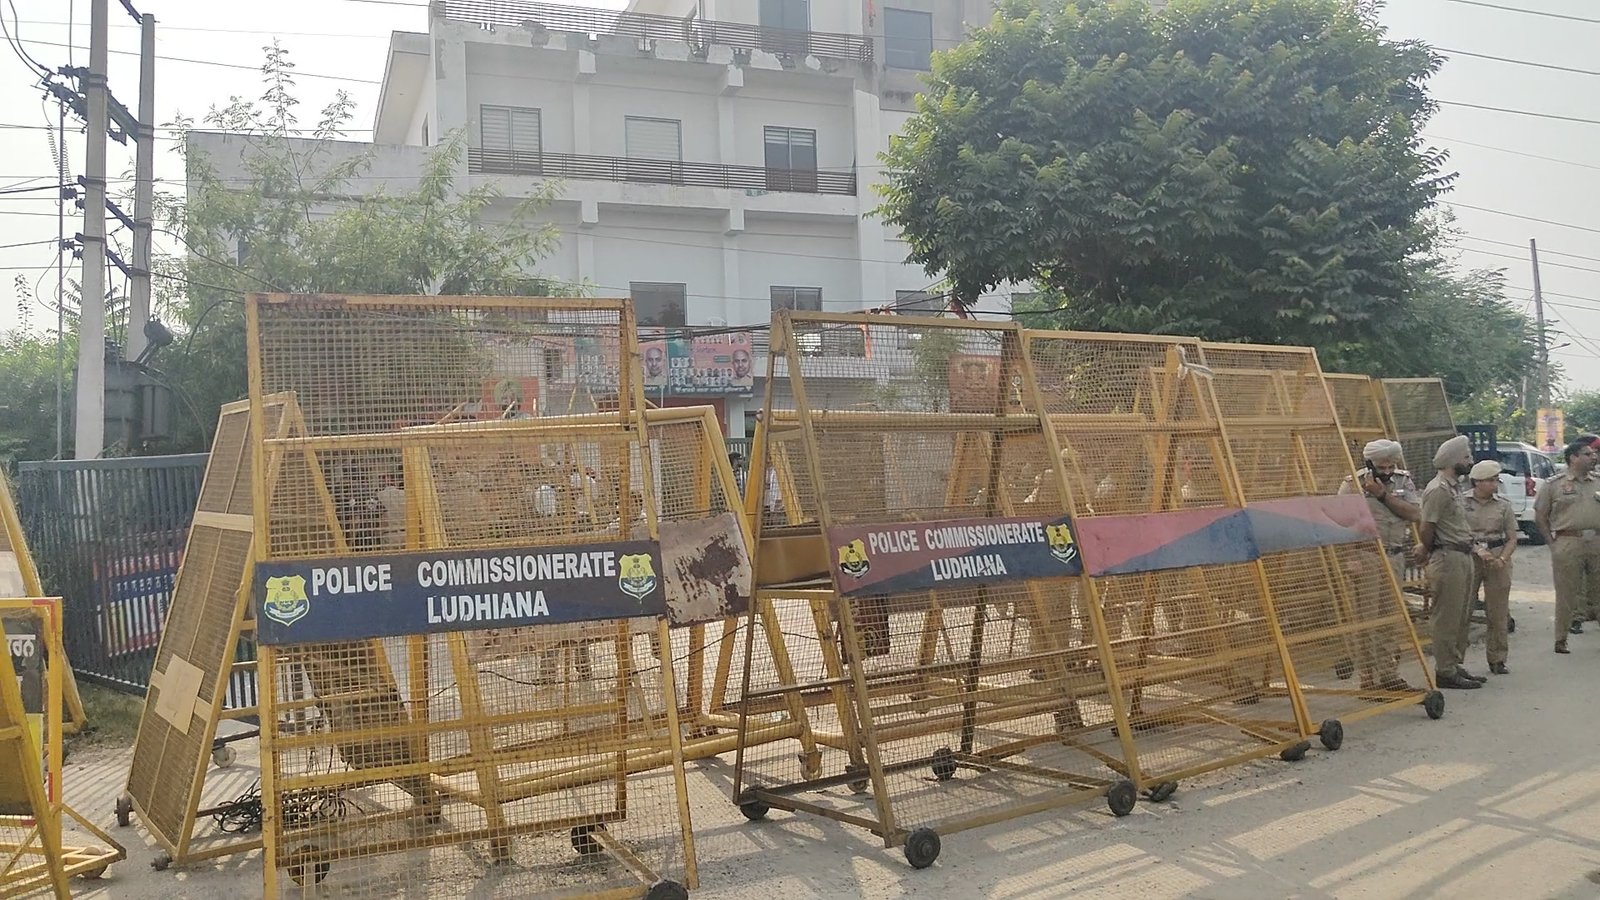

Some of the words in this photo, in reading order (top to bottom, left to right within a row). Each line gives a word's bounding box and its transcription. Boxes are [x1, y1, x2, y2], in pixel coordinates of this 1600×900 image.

[867, 530, 919, 554] POLICE
[924, 521, 1045, 549] COMMISSIONERATE
[311, 564, 392, 595] POLICE
[417, 551, 615, 587] COMMISSIONERATE
[931, 554, 1007, 580] LUDHIANA
[427, 591, 549, 623] LUDHIANA
